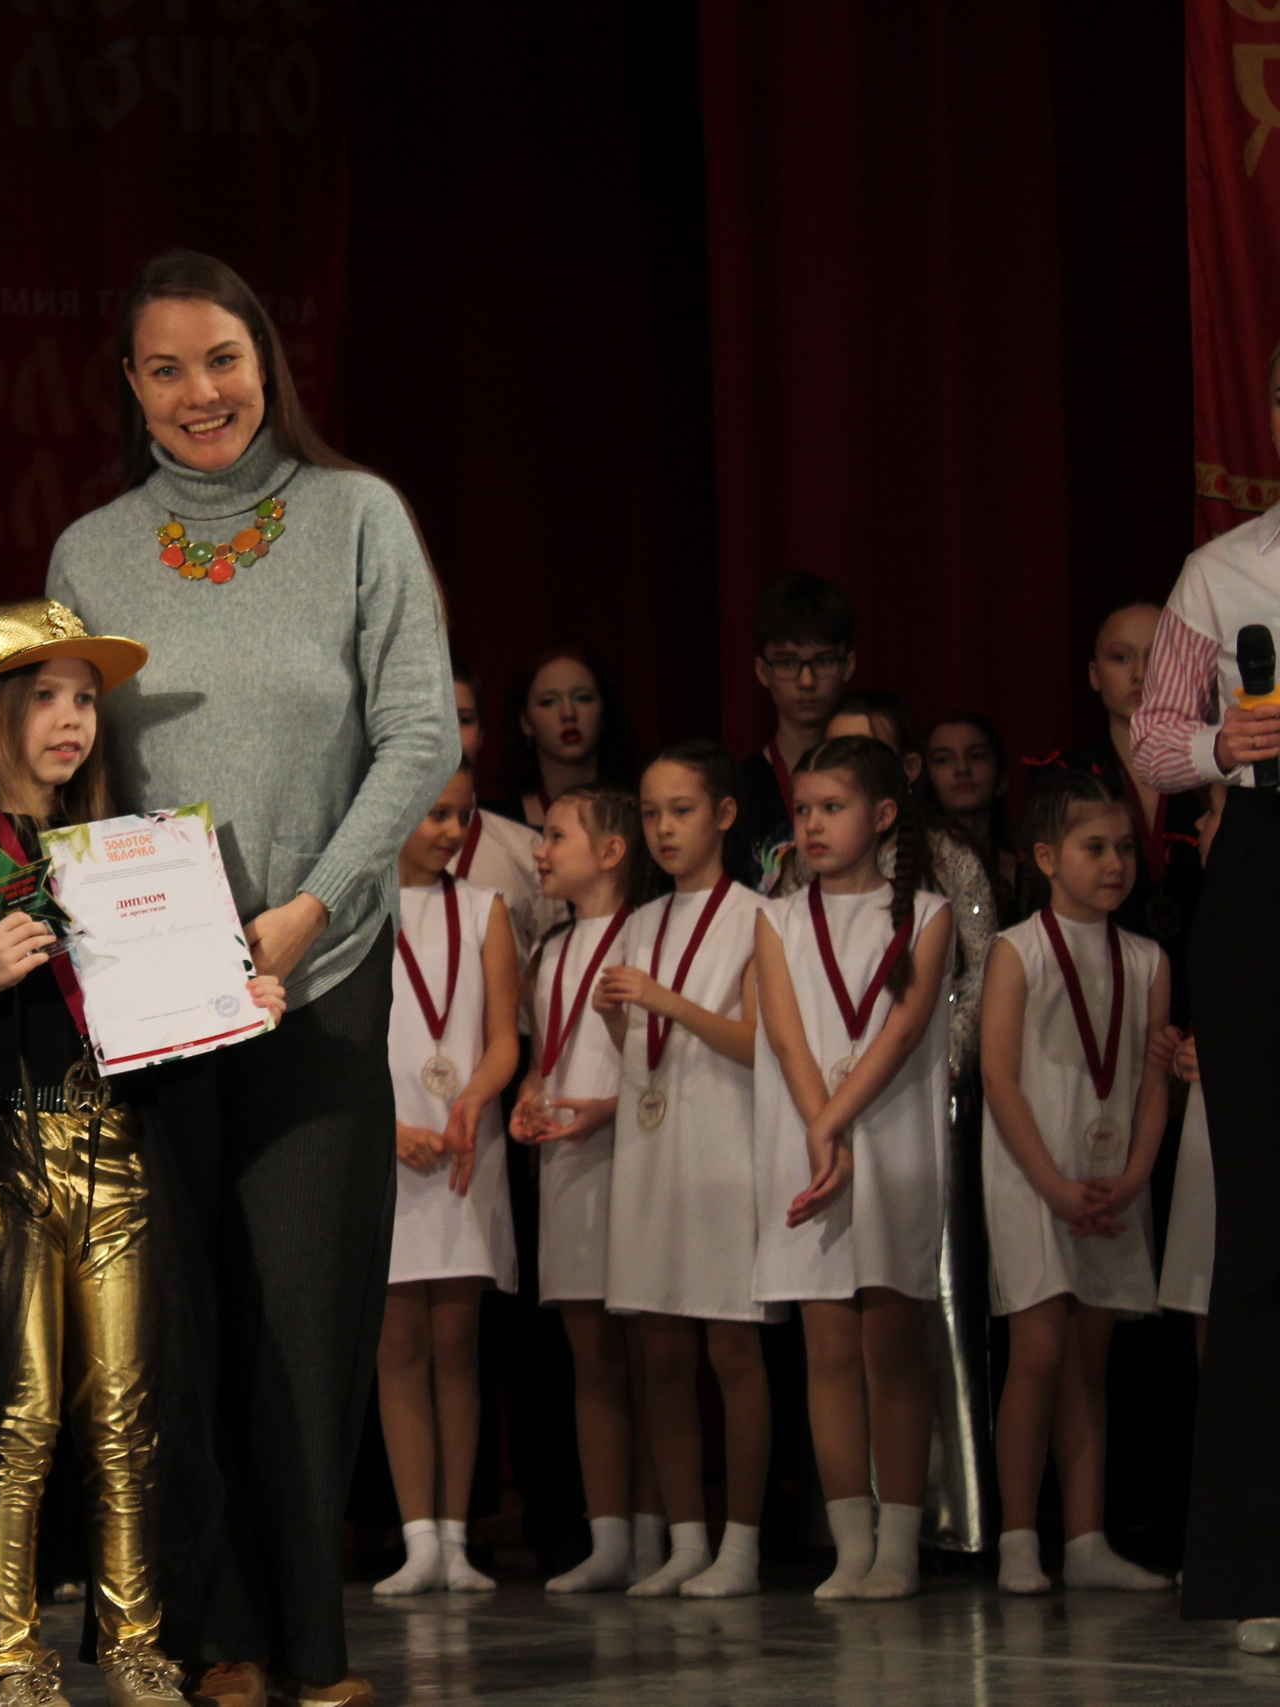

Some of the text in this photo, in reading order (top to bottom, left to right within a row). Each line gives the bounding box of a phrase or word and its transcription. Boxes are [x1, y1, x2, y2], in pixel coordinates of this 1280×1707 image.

[103, 833, 153, 851] ЗОЛОТОЕ
[107, 845, 155, 863] ЯБЛОЧКО
[116, 893, 166, 910] ДИПЛОМ
